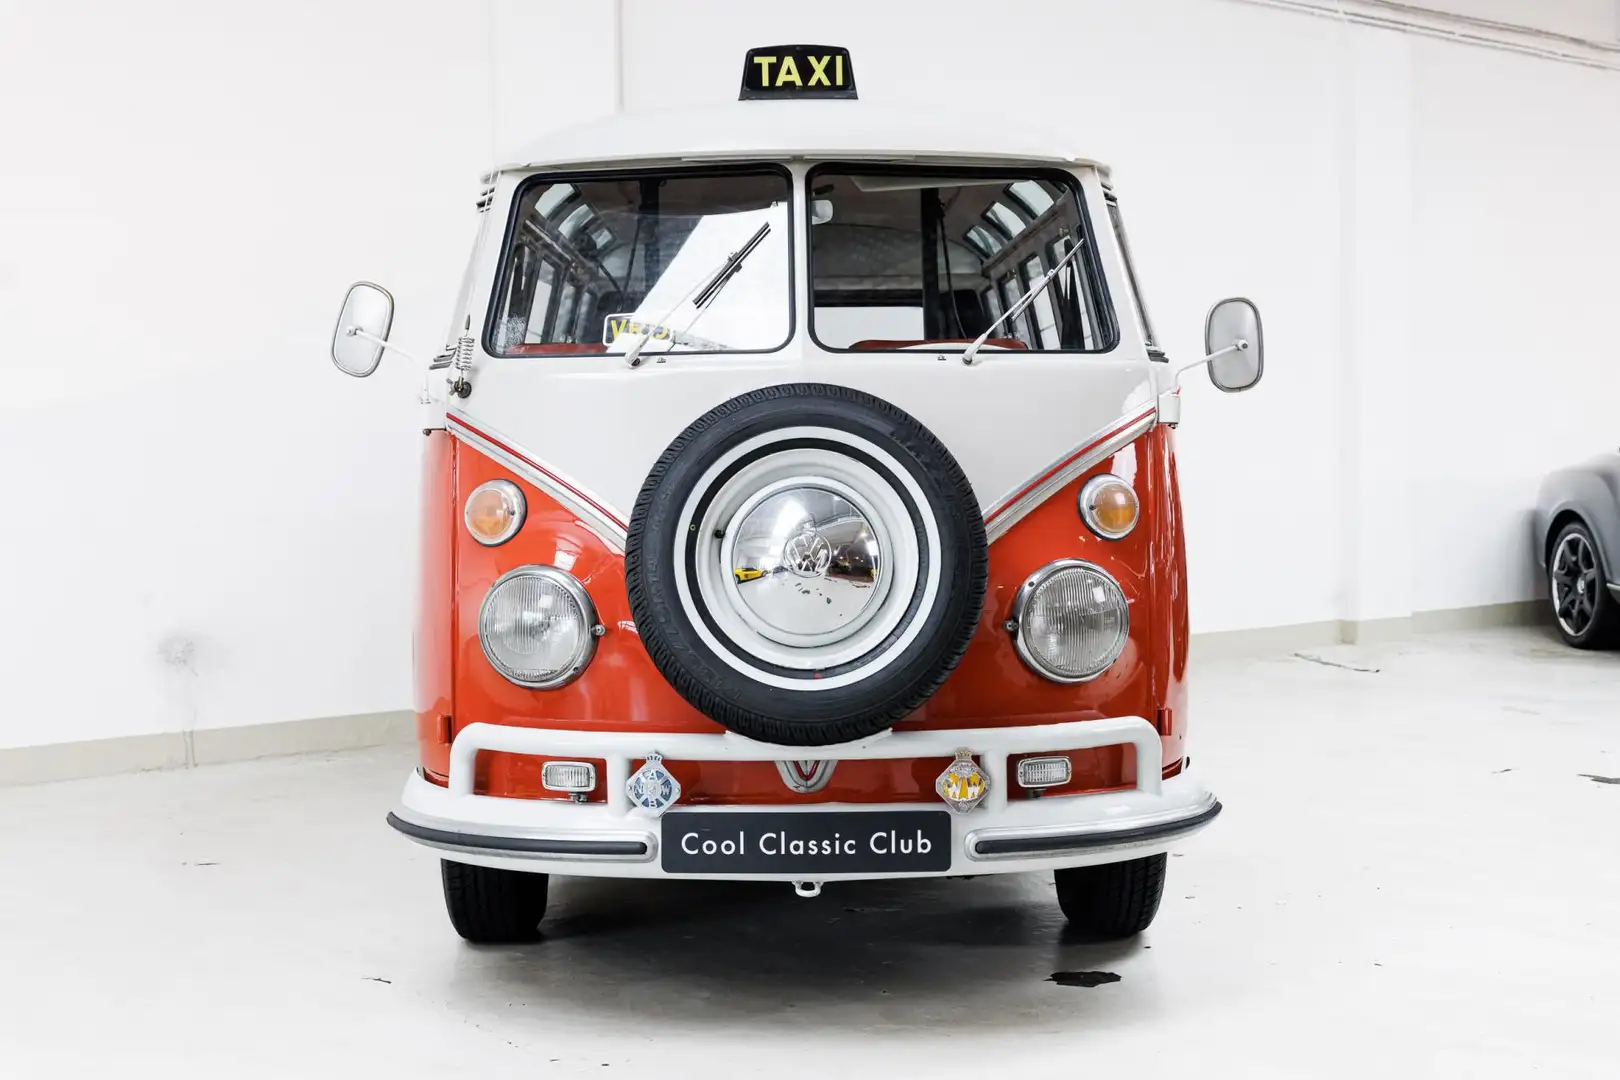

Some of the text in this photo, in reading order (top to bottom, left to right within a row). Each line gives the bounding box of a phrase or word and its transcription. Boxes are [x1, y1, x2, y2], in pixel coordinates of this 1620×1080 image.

[753, 55, 844, 87] TAXI
[681, 829, 933, 855] Cool Classic Club
